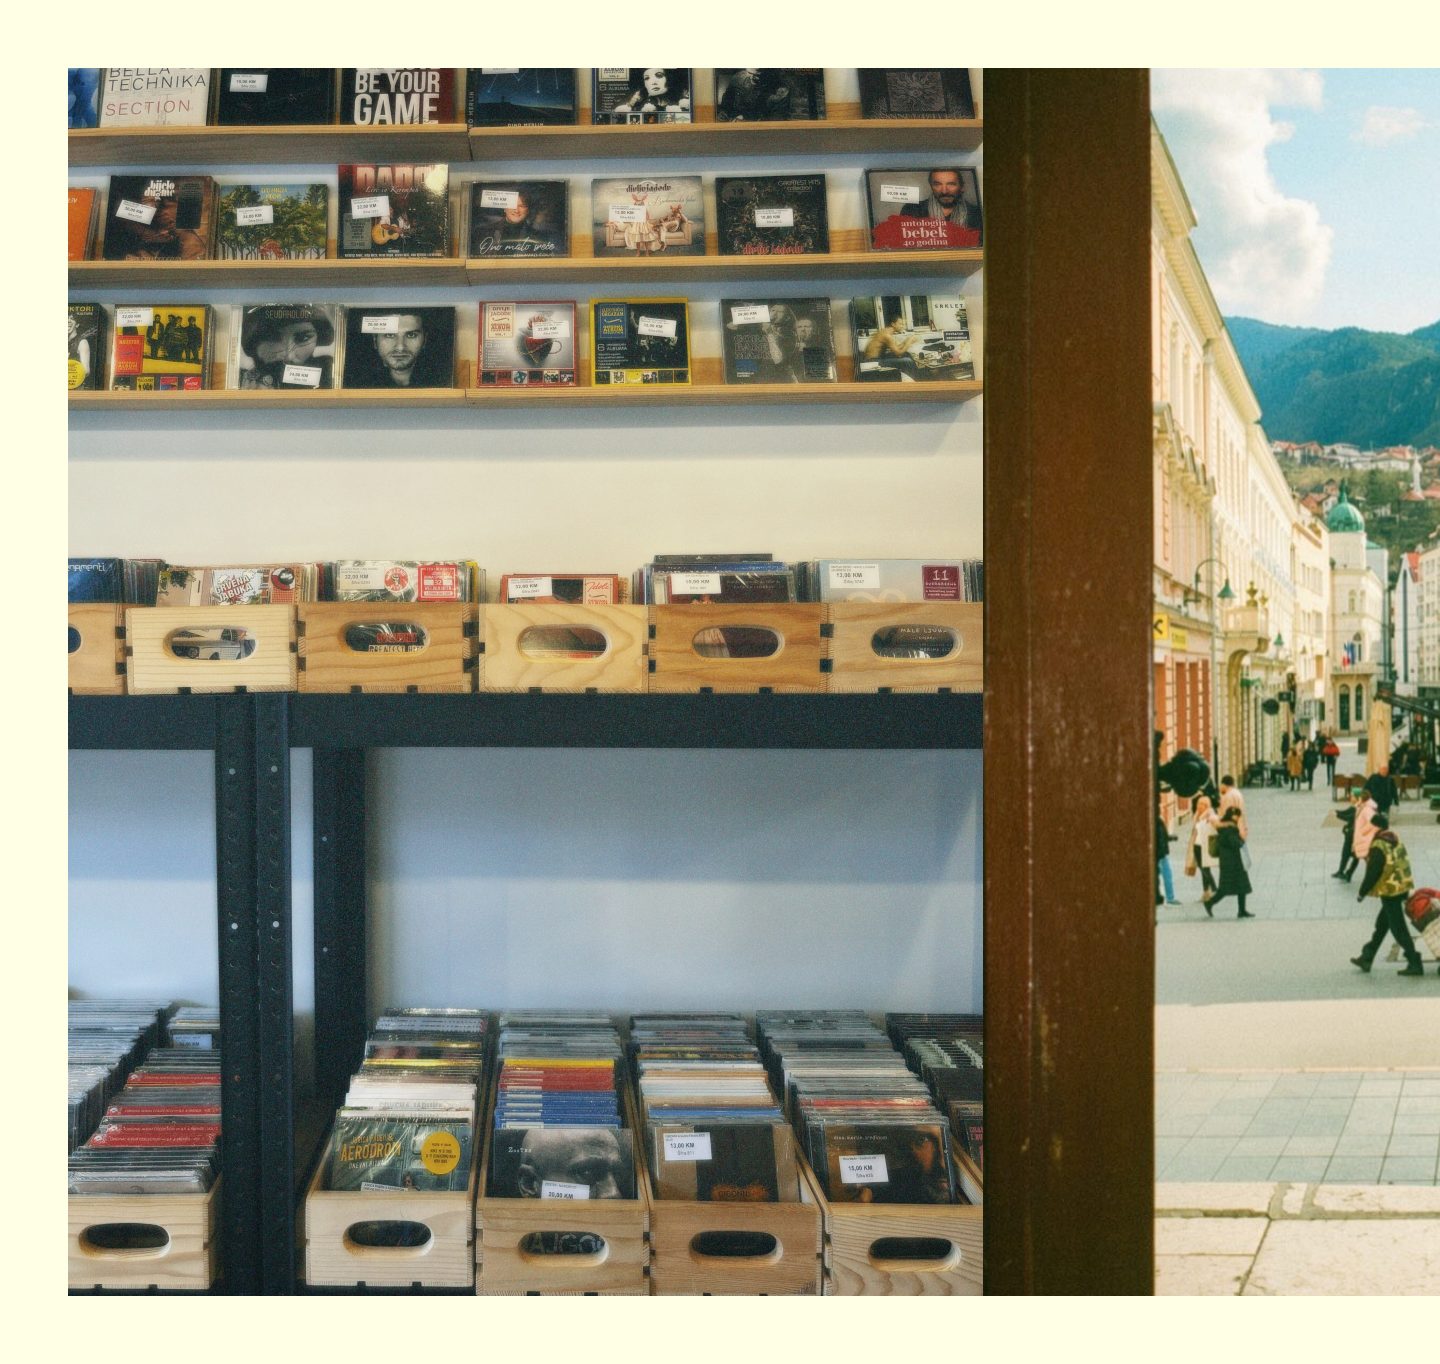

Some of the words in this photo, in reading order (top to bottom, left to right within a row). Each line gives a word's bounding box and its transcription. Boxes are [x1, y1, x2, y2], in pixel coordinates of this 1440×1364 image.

[109, 68, 170, 78] BELLA
[109, 74, 206, 91] TECHNIKA
[354, 72, 380, 93] BE
[386, 71, 440, 93] YOUR
[105, 99, 190, 116] SECTION
[353, 93, 440, 125] GAME
[901, 219, 947, 228] antologija
[902, 227, 948, 239] bebek
[917, 239, 948, 247] godina
[933, 569, 949, 581] 11
[219, 583, 253, 602] JABUKA
[340, 1142, 401, 1161] AERODROM
